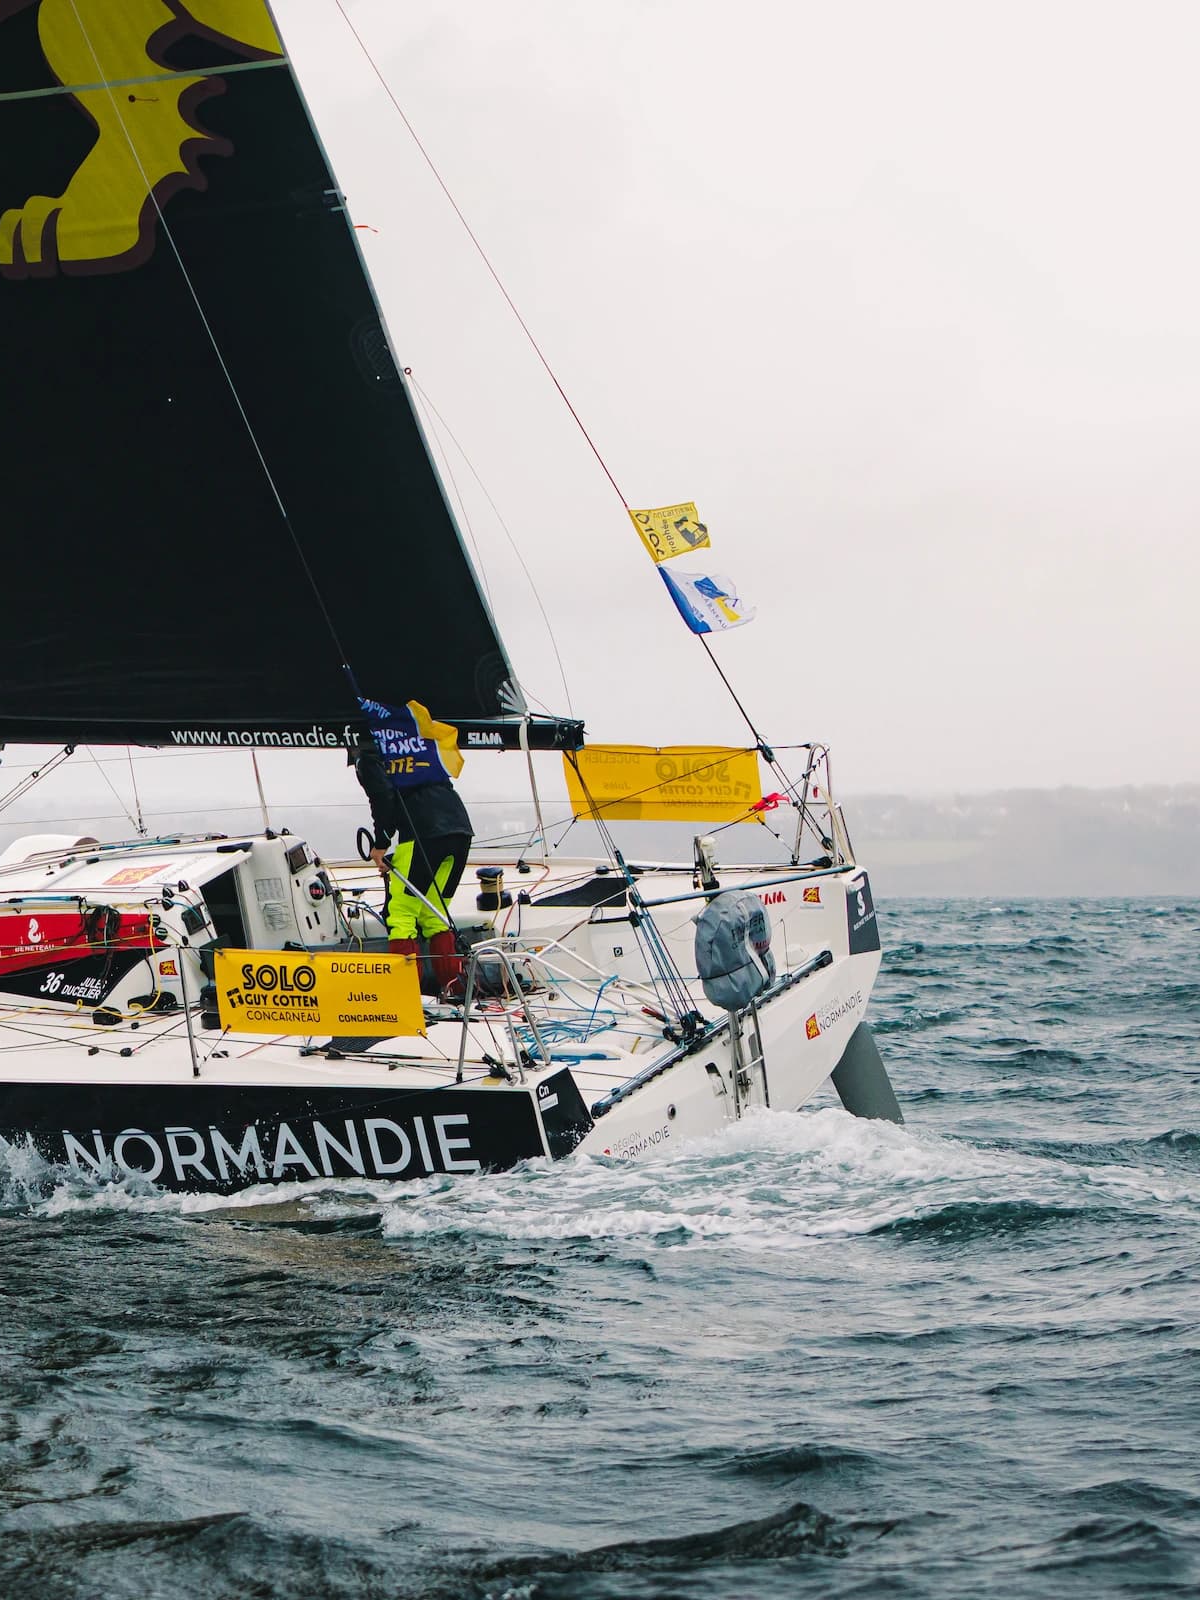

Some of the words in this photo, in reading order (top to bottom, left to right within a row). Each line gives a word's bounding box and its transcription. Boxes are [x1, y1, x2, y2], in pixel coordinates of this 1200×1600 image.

[171, 725, 360, 746] www.normandie.fr
[467, 732, 503, 745] SLAM
[331, 962, 391, 974] DUCELIER
[40, 972, 64, 994] 36
[242, 964, 316, 992] SOLO
[61, 984, 101, 1000] DUCELIER
[347, 992, 378, 1002] Jules
[245, 993, 268, 1006] GUY
[272, 994, 319, 1008] COTTEN
[246, 1010, 321, 1023] CONCARNEAU
[338, 1014, 399, 1023] CONCARNEAU
[819, 990, 863, 1032] NORMANDIE
[62, 1114, 482, 1183] NORMANDIE
[620, 1125, 670, 1160] ORMANDIE
